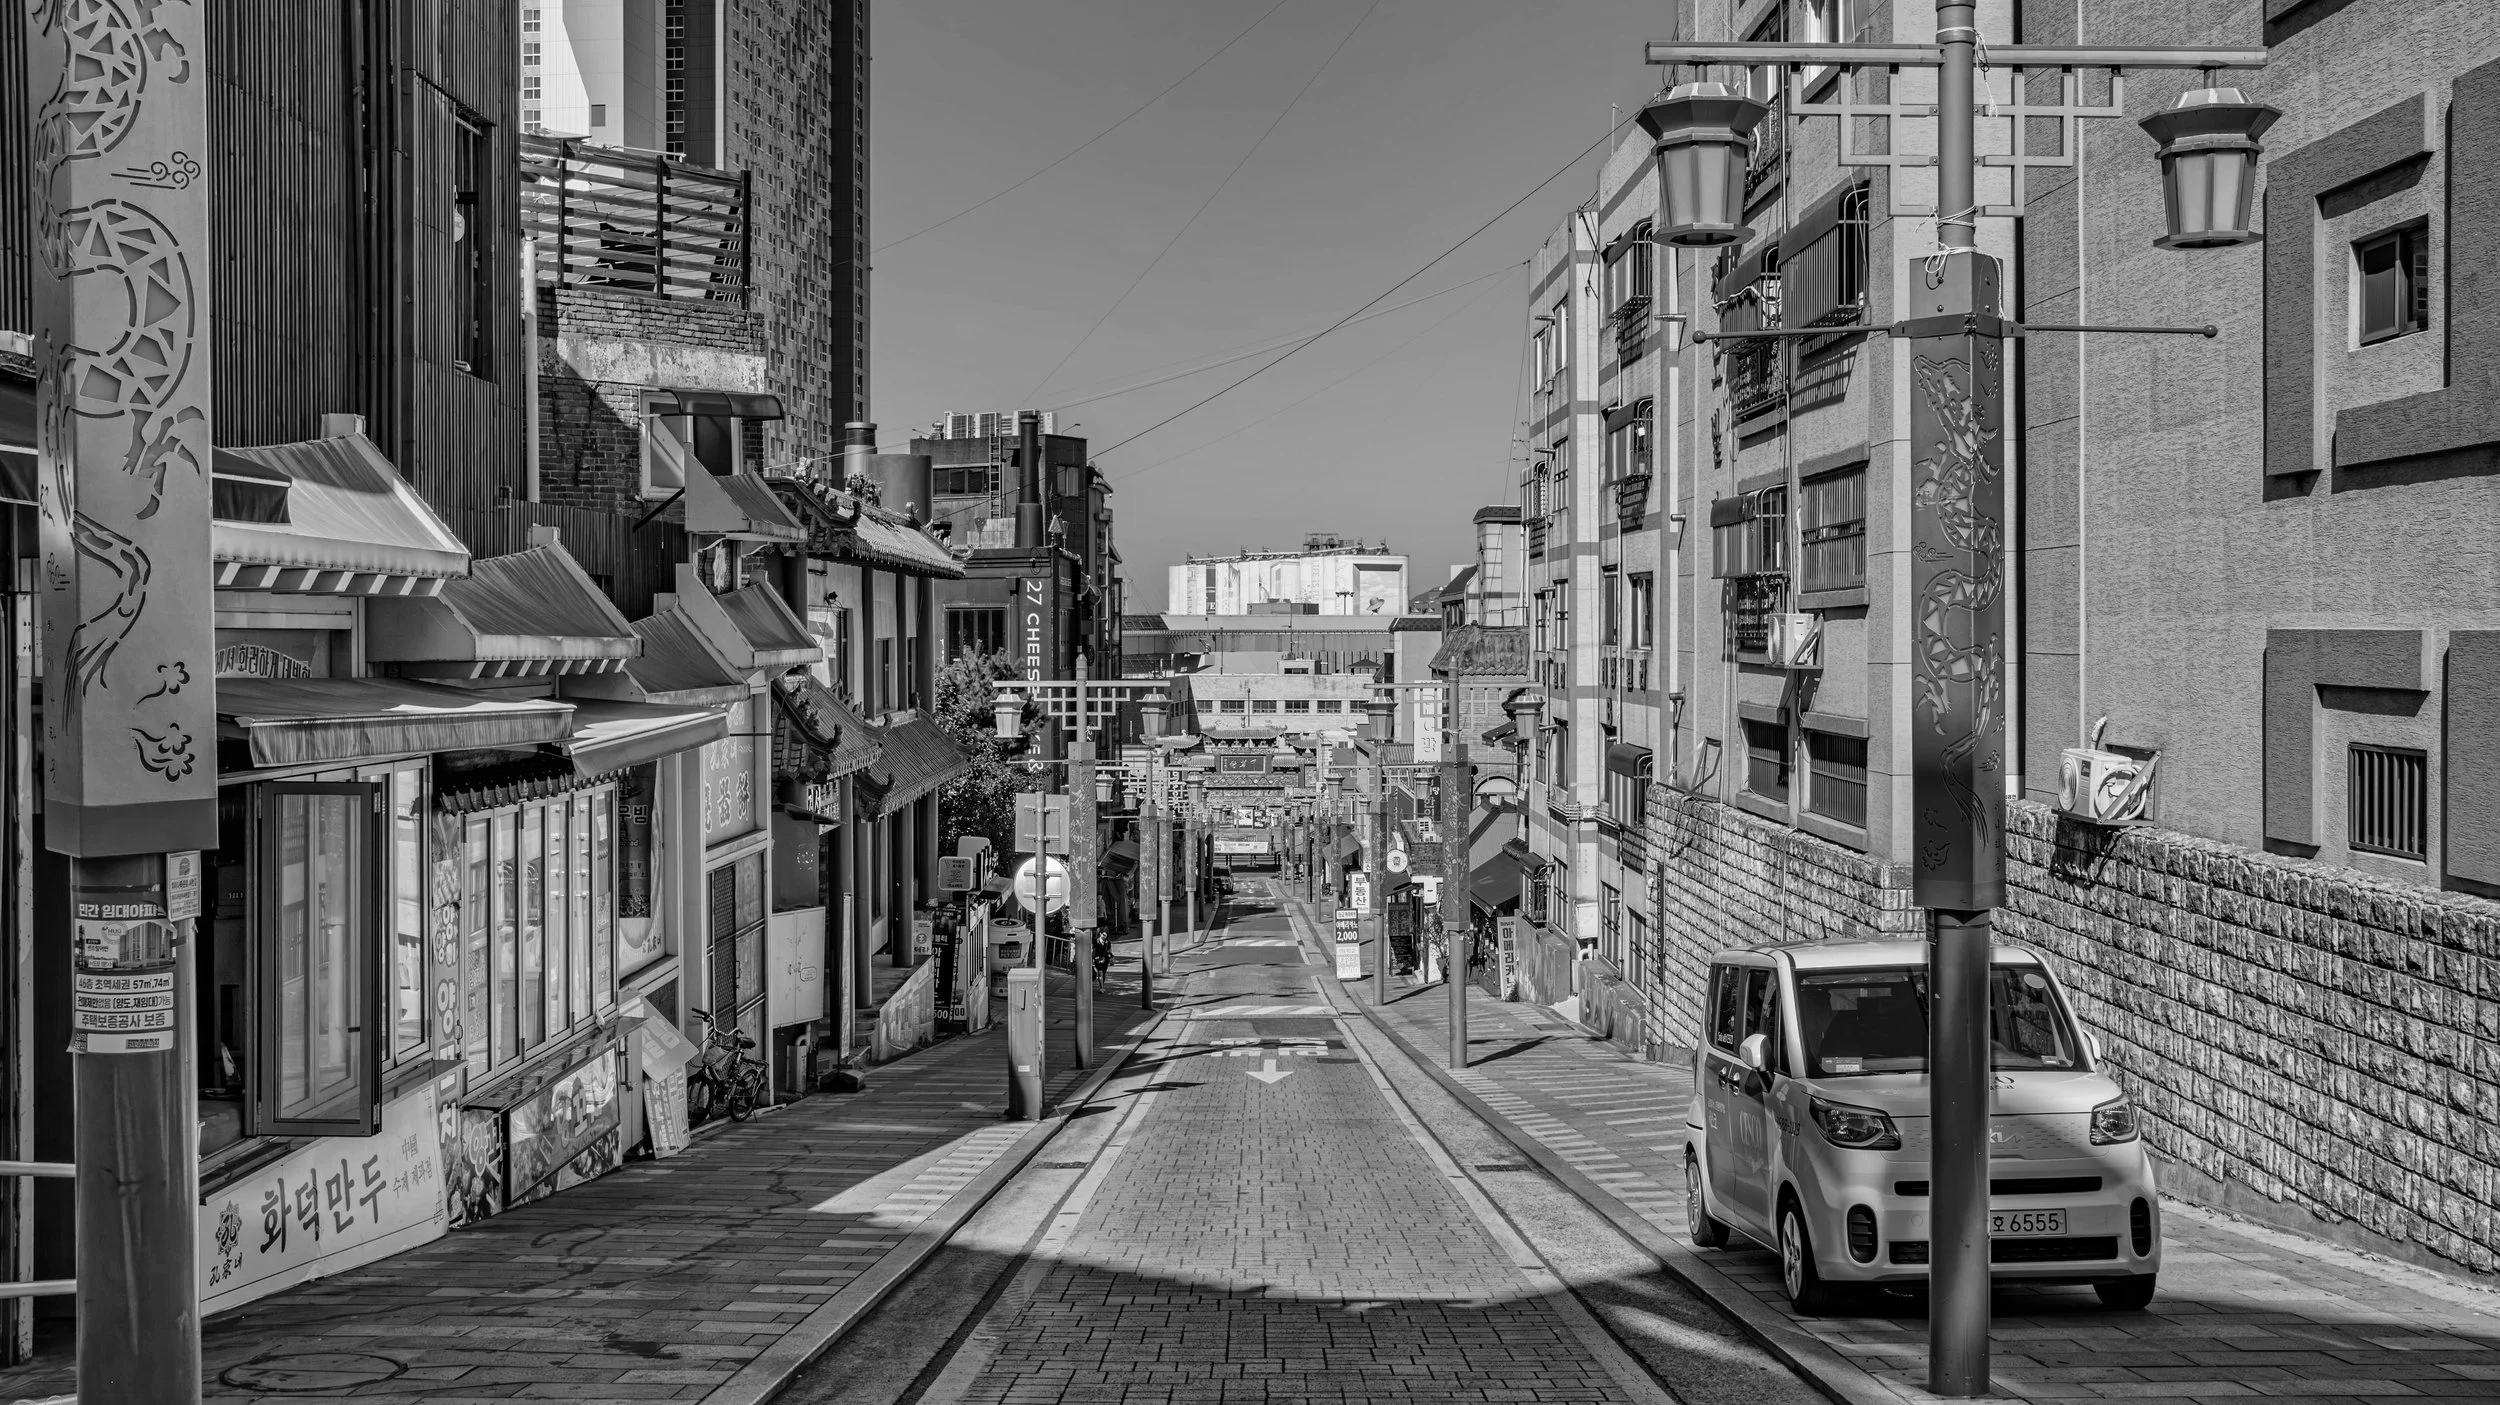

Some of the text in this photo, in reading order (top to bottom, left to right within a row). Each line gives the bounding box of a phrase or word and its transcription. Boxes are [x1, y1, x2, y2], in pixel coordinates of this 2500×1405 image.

[1026, 580, 1043, 606] 27
[1354, 876, 1367, 906] 부동산
[79, 903, 99, 918] 민간
[1336, 930, 1358, 942] 2,000
[95, 978, 131, 990] 초역세권
[81, 1012, 165, 1029] 주택보증공사 보증
[260, 1154, 387, 1254] 화덕만두
[2010, 1213, 2060, 1233] 6555
